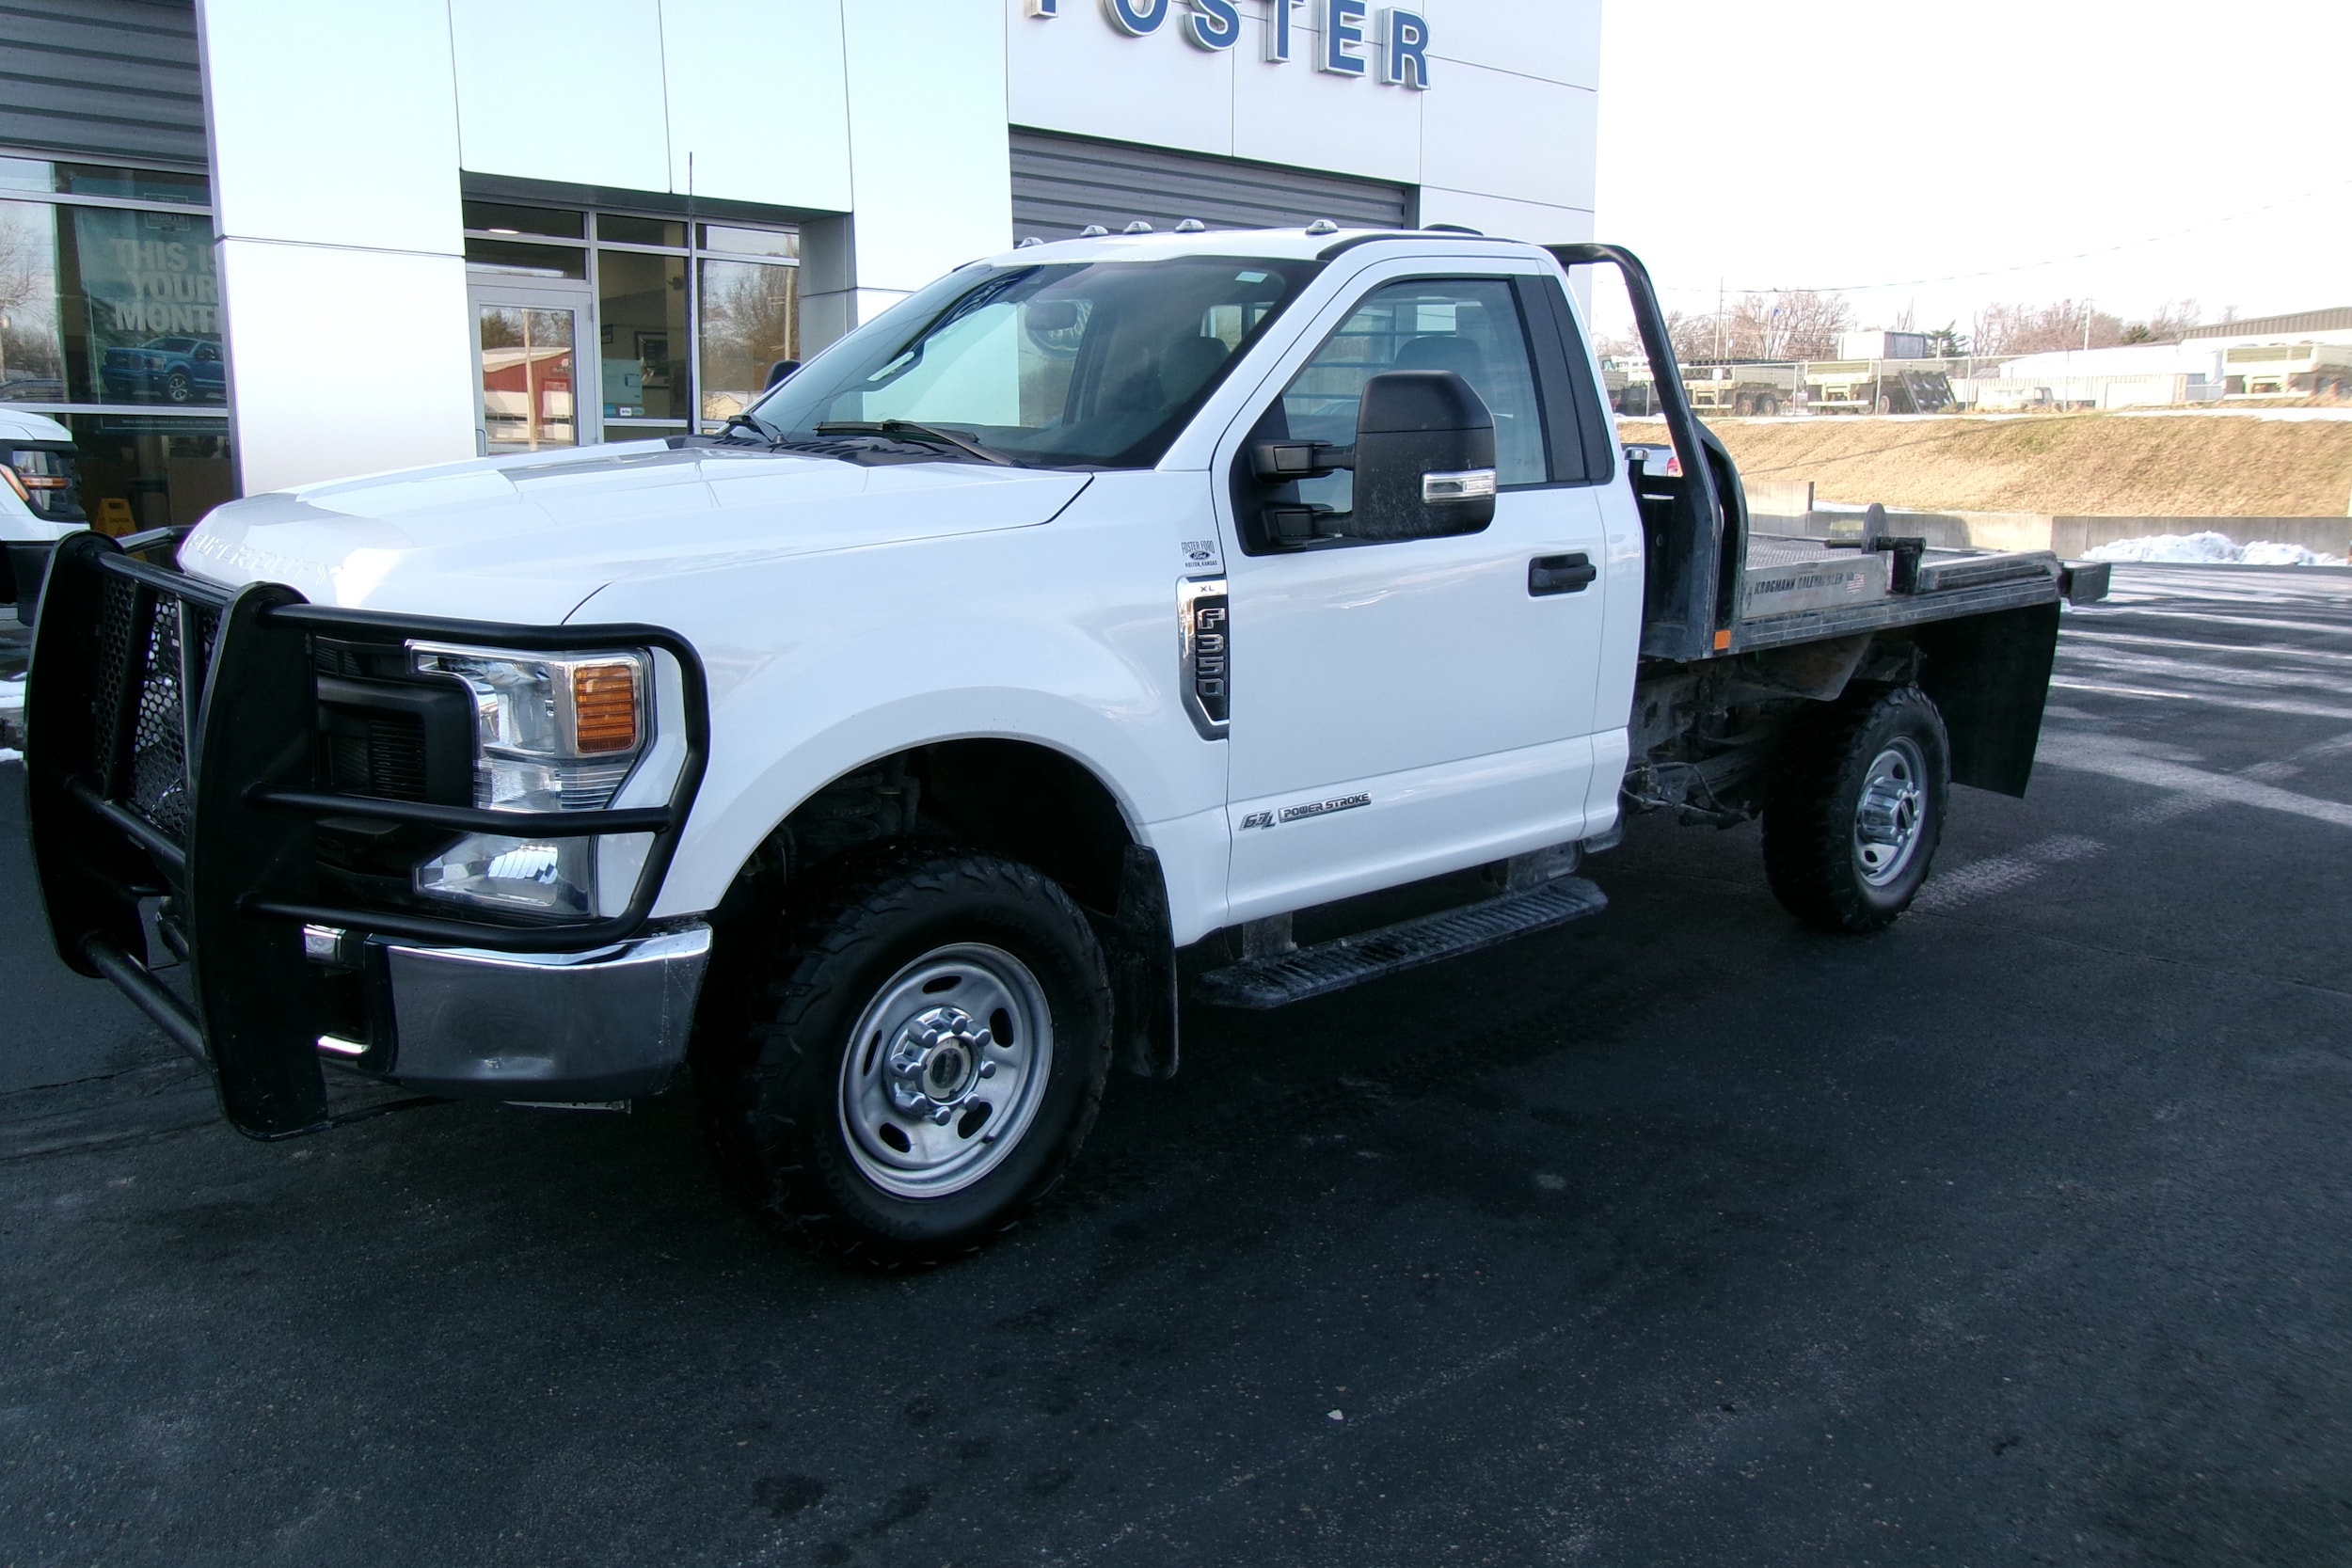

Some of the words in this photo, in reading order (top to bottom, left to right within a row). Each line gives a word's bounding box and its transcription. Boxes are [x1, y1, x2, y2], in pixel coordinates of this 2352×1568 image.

[1028, 0, 1431, 90] STER
[108, 238, 188, 272] THIS
[127, 271, 219, 303] YOUR
[1283, 802, 1323, 818] POWER
[1326, 793, 1370, 809] STROKE
